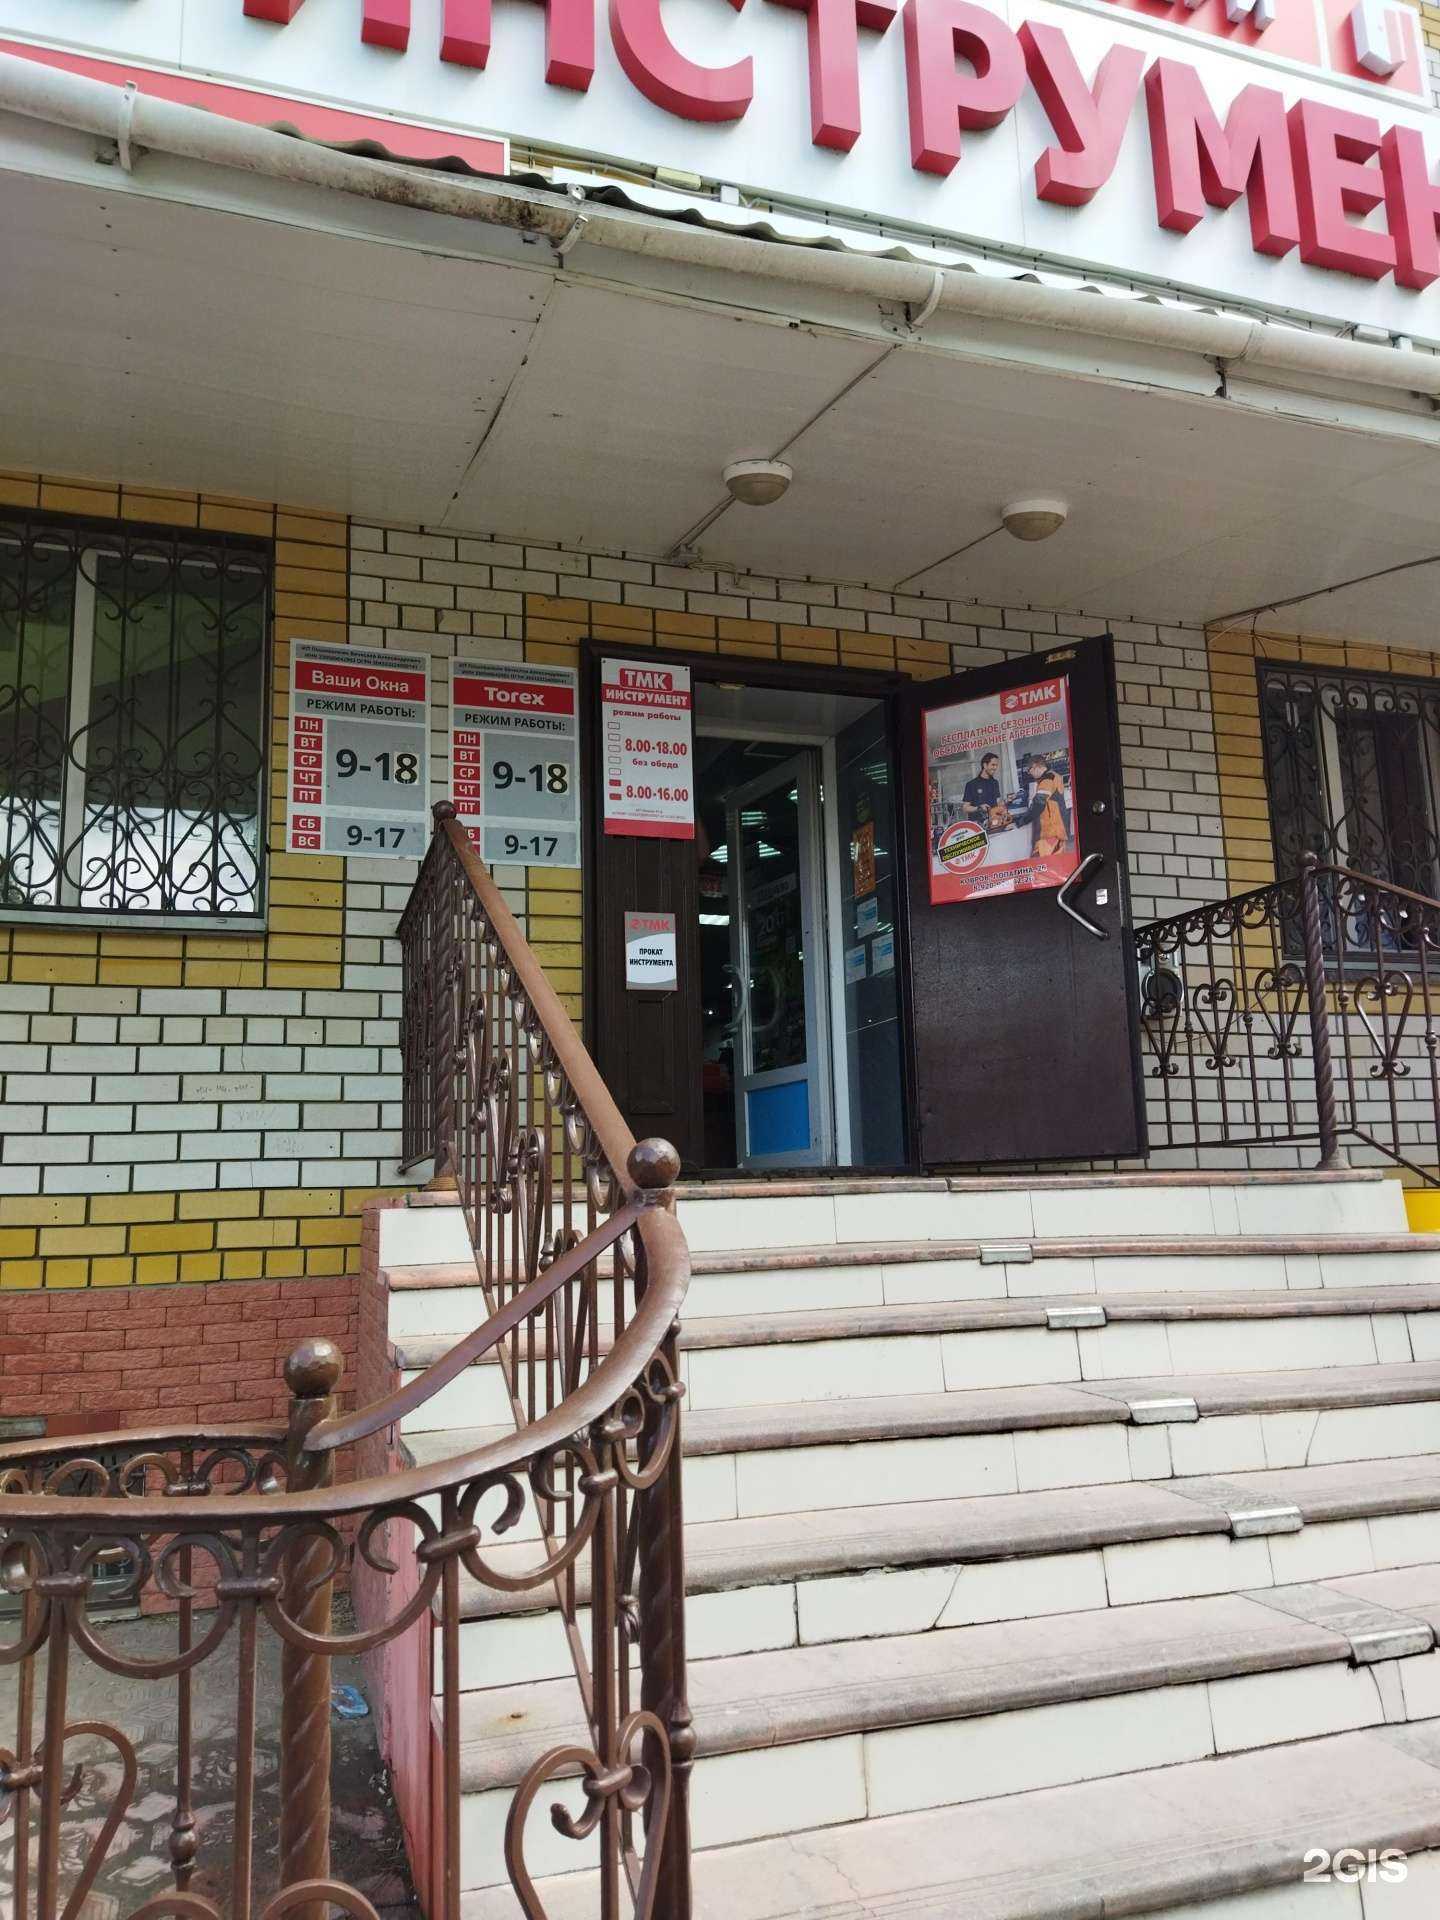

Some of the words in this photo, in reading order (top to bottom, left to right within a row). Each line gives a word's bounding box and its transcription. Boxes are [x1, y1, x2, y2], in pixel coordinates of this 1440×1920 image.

[243, 0, 1440, 293] СТРУМЕН
[312, 669, 360, 688] Ваши
[366, 676, 409, 693] Окна
[624, 671, 668, 690] ТМК
[484, 686, 545, 706] Torex
[605, 688, 688, 706] ИНСТРУМЕНТ
[1019, 685, 1056, 706] ТМК
[307, 698, 356, 712] РЕЖИМ
[360, 703, 416, 718] РАБОТЫ:
[612, 709, 645, 718] режим
[647, 711, 681, 721] работы
[300, 720, 318, 730] ПН
[465, 713, 511, 726] РЕЖИМ
[514, 718, 566, 731] РАБОТЫ:
[940, 723, 999, 746] БЕСПЛАТНОЕ
[1001, 711, 1050, 731] СЕЗОННОЕ
[300, 737, 317, 747] ВТ
[459, 733, 476, 743] ПН
[625, 738, 688, 756] 8.00-18.00
[932, 735, 1007, 759] ОБСЛУЖИВАНИЕ
[300, 755, 317, 765] СР
[460, 751, 475, 761] ВТ
[632, 758, 648, 766] без
[650, 760, 679, 769] обеда
[336, 749, 418, 784] 9-18
[459, 768, 475, 778] СР
[299, 773, 316, 783] ЧТ
[492, 761, 568, 794] 9-18
[299, 791, 316, 801] ПТ
[459, 785, 475, 795] ЧТ
[459, 802, 476, 812] ПТ
[298, 818, 316, 829] СБ
[298, 836, 315, 847] ВС
[346, 825, 406, 848] 9-17
[504, 834, 558, 857] 9-17
[629, 958, 674, 966] ИНСТРУМЕНТА
